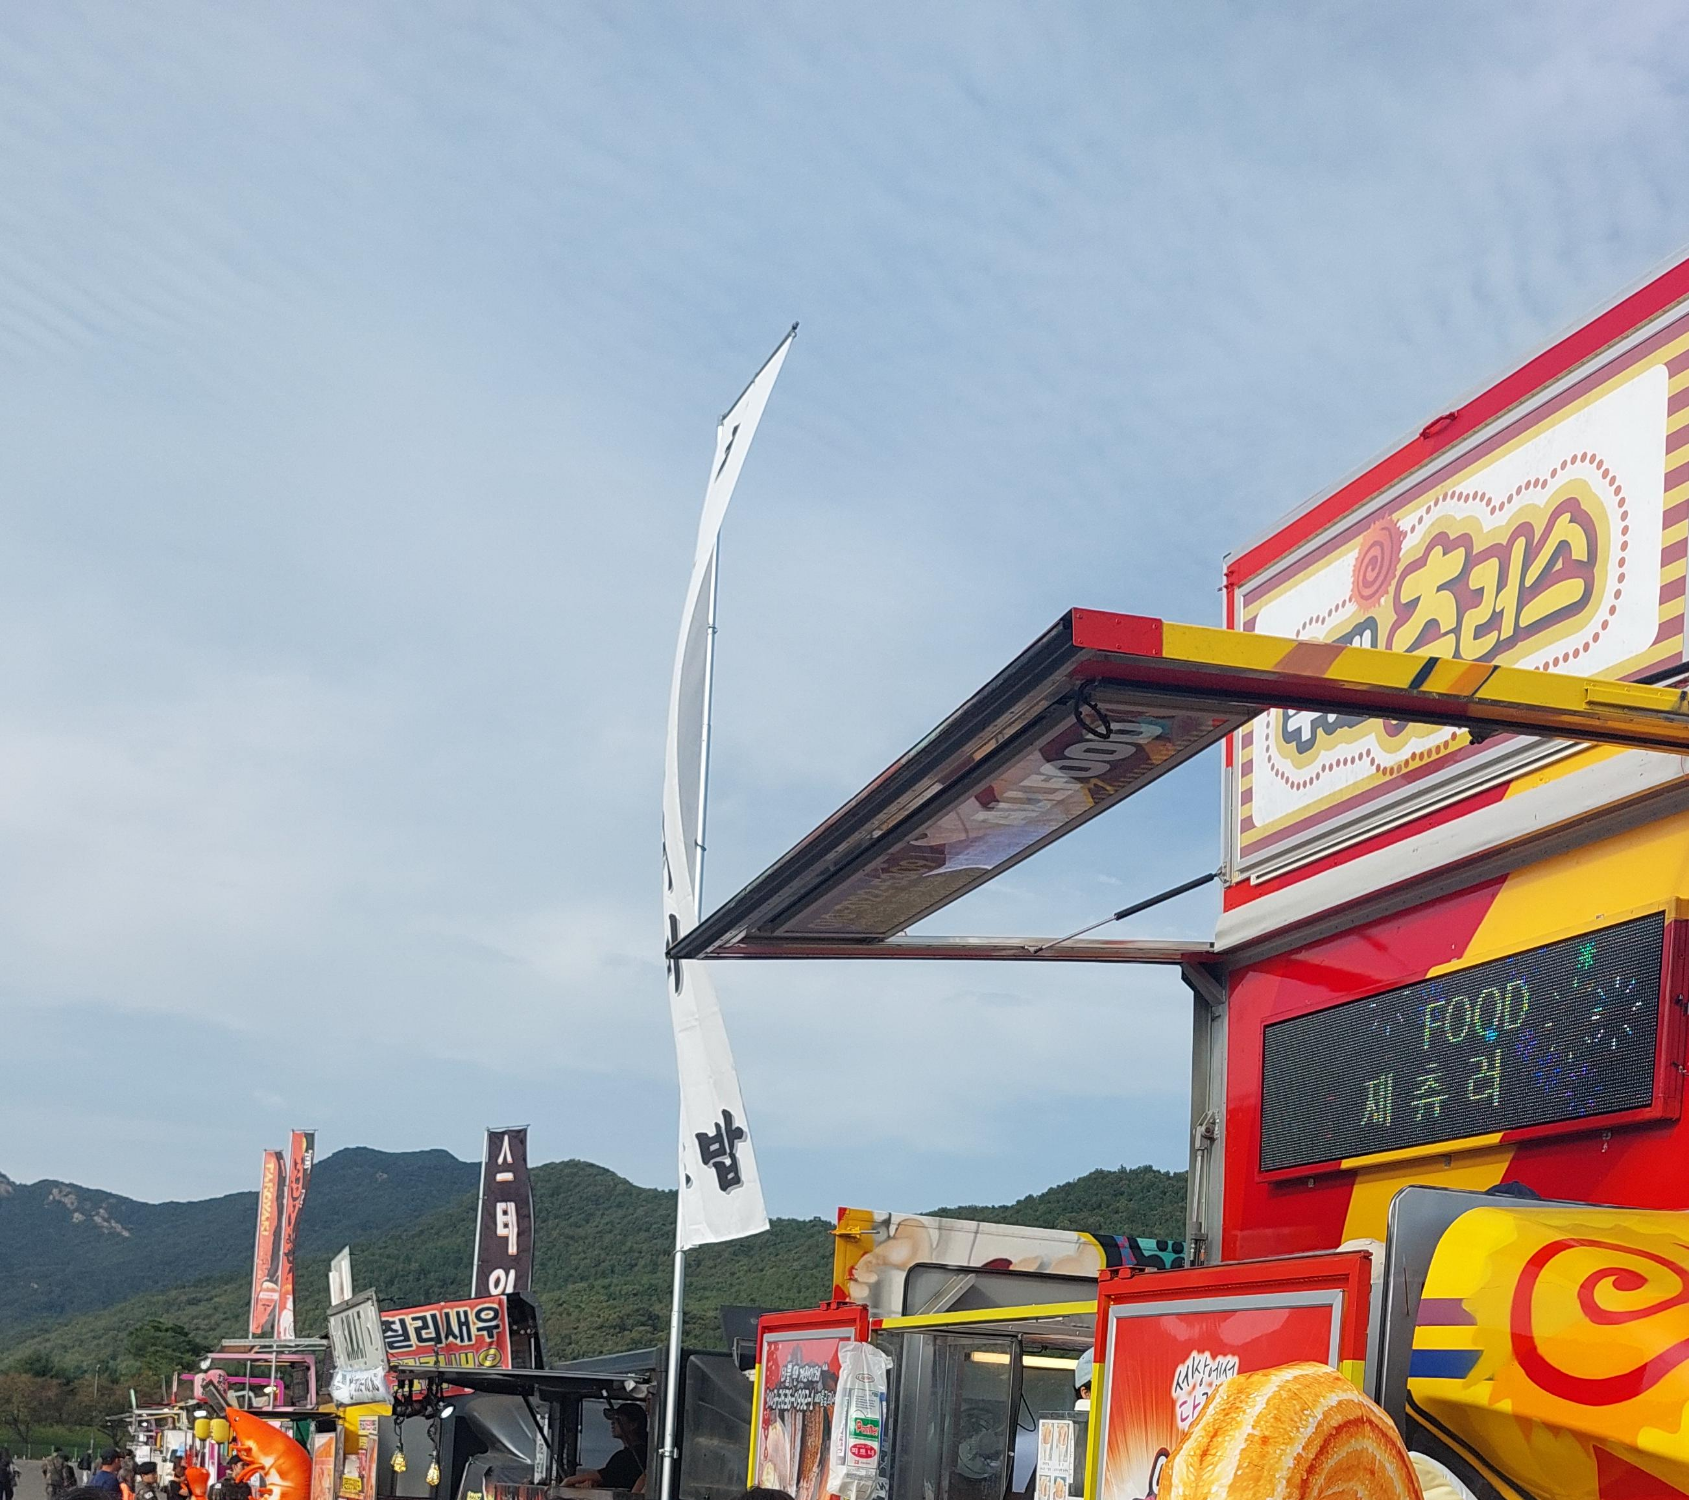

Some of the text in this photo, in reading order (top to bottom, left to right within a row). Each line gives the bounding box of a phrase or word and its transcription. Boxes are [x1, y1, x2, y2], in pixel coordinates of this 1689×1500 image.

[1423, 980, 1530, 1050] FOOD
[381, 1305, 502, 1351] 칠리새우
[1173, 1355, 1237, 1394] 세상에서
